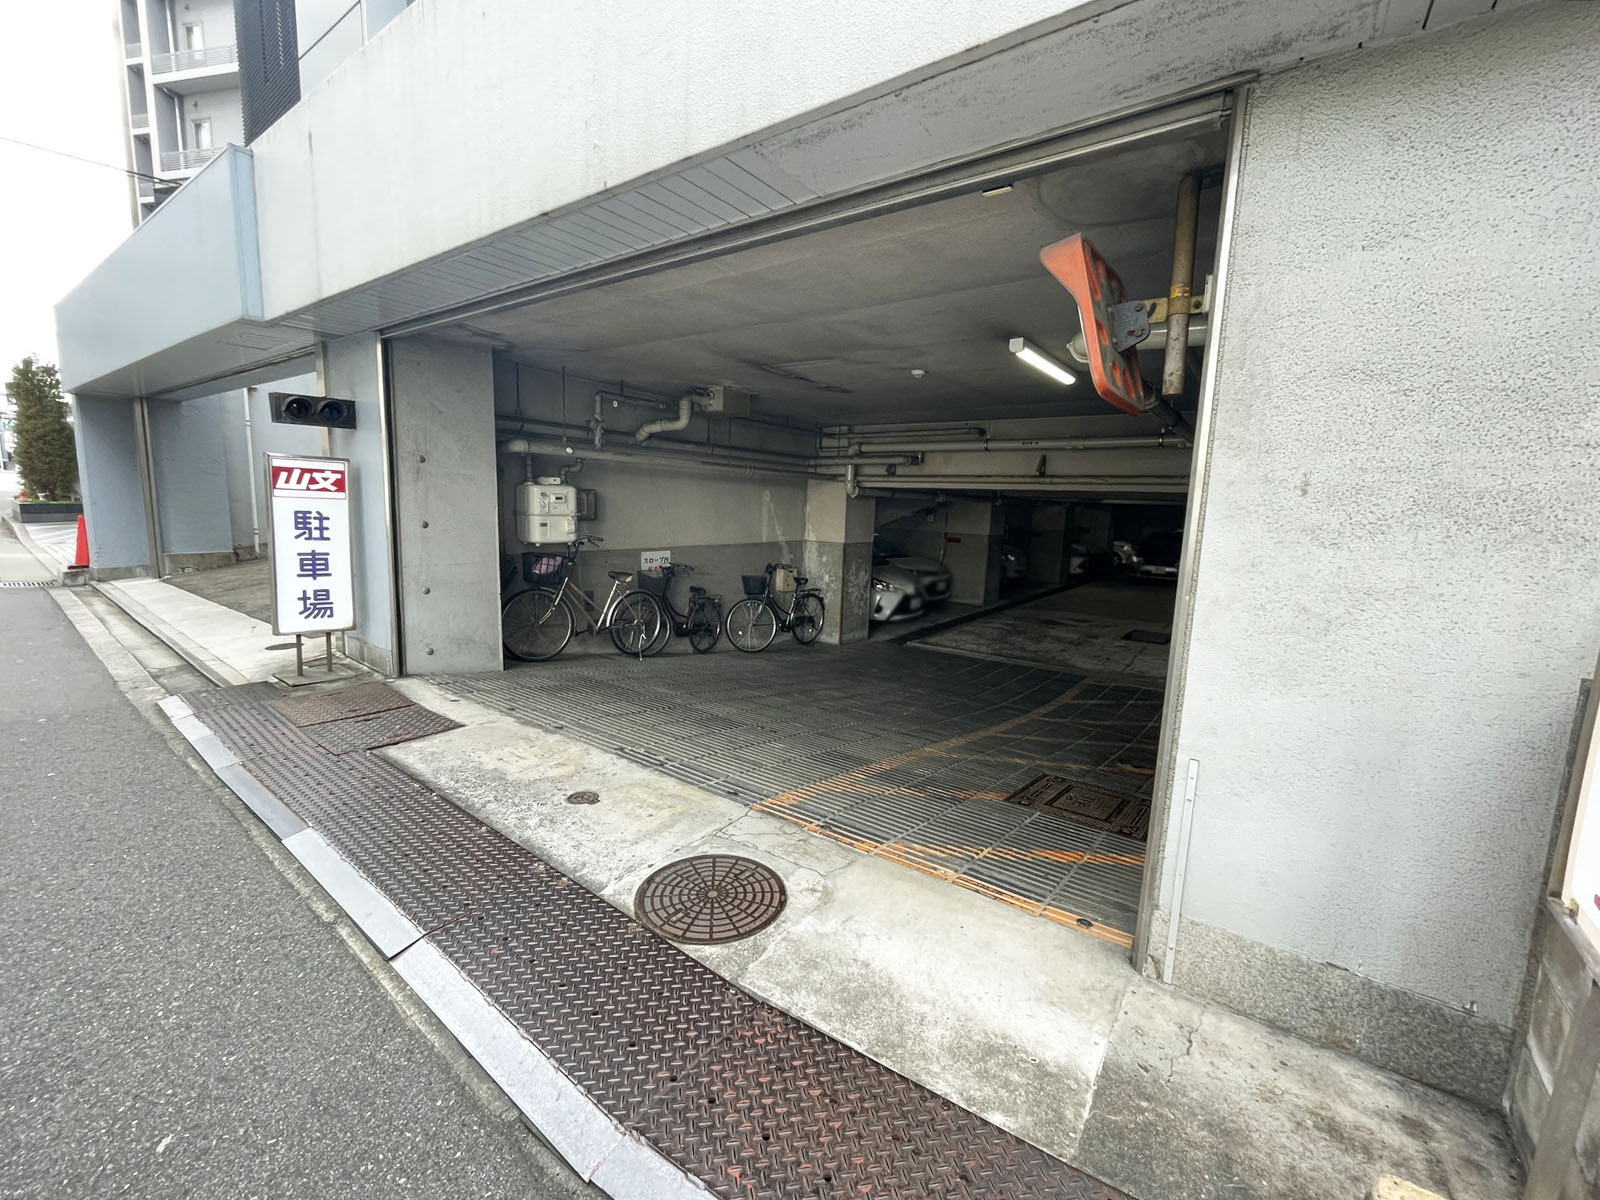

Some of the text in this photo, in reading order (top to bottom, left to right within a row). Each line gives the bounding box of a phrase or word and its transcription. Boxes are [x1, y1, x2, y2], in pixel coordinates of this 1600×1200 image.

[275, 468, 342, 492] 山文
[294, 510, 334, 620] 駐車場
